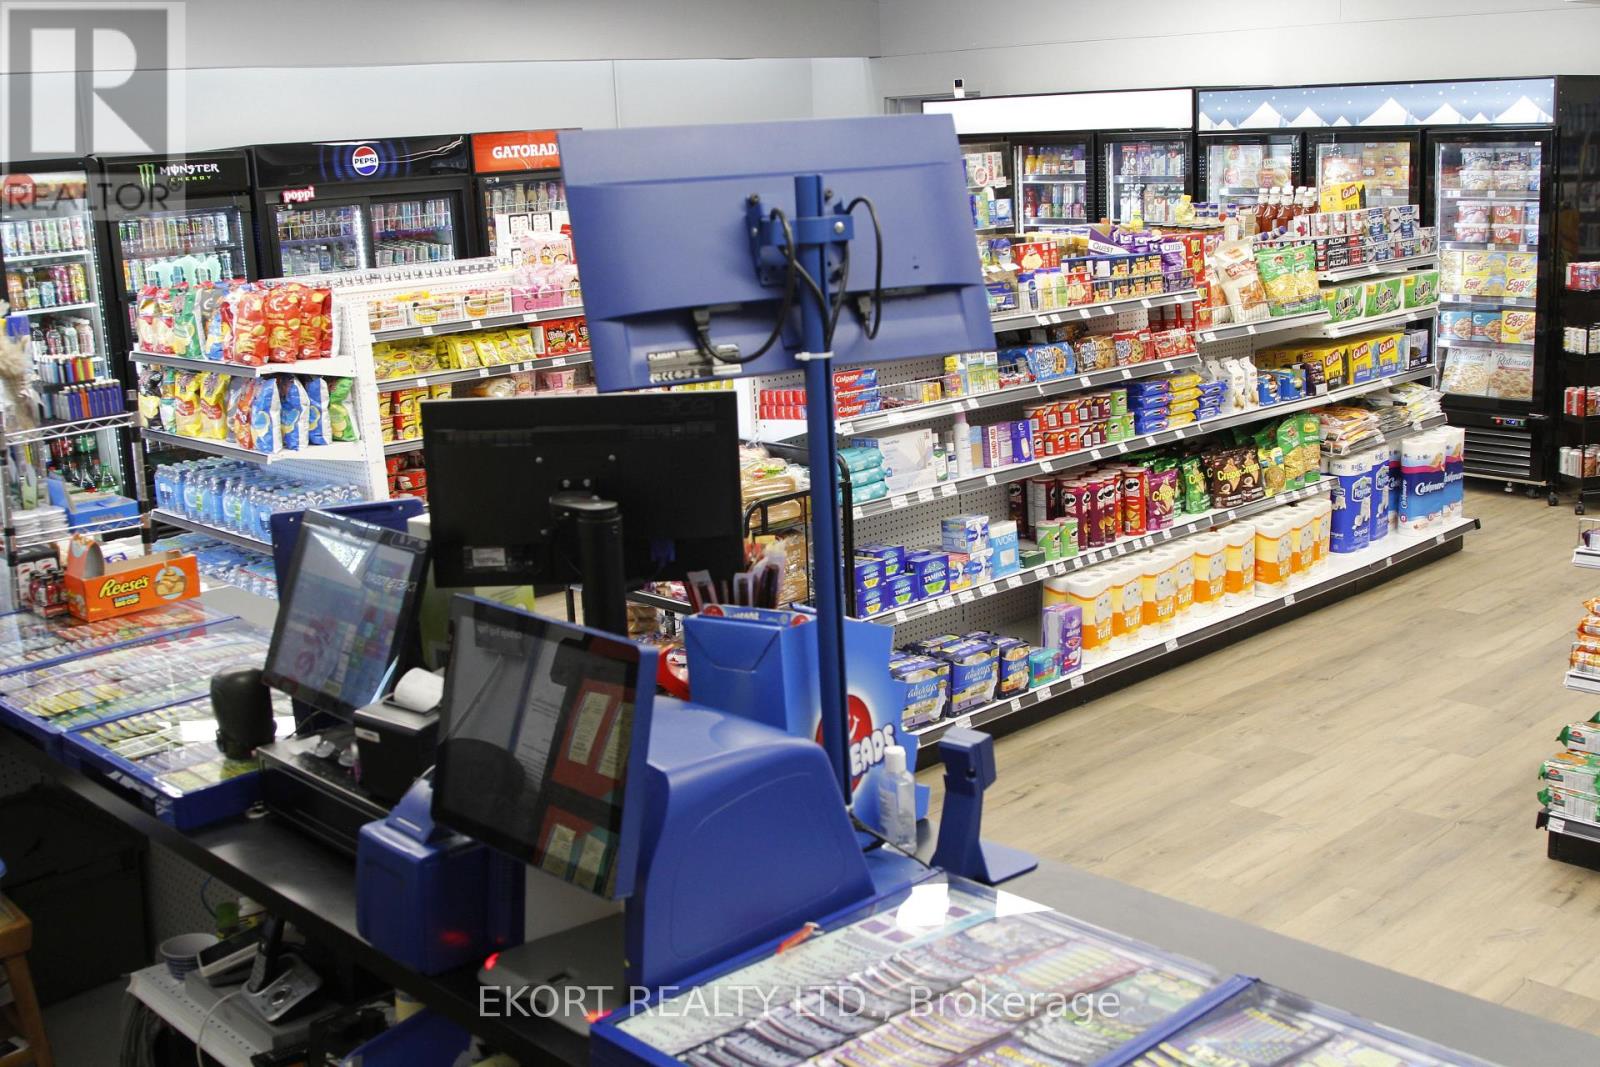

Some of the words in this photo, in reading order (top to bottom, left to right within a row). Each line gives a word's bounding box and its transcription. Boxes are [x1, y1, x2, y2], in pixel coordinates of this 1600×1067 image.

[492, 143, 560, 159] GATORAD
[159, 163, 220, 178] MONSTER
[354, 158, 377, 169] PEPSI
[283, 187, 316, 203] poppi
[1342, 185, 1356, 199] GLAD
[1328, 236, 1347, 246] ALCAN
[1329, 256, 1349, 268] ALCAN
[1506, 278, 1532, 292] Eggo
[1505, 312, 1529, 327] Eggo
[1352, 342, 1370, 360] GLAD
[1380, 337, 1396, 354] GLAD
[1325, 350, 1341, 367] GLAD
[835, 374, 860, 386] Colgate
[837, 404, 864, 417] Colgate
[923, 569, 948, 583] TAMPAX
[1157, 602, 1174, 617] Tuff
[964, 664, 992, 681] always
[906, 681, 937, 700] always
